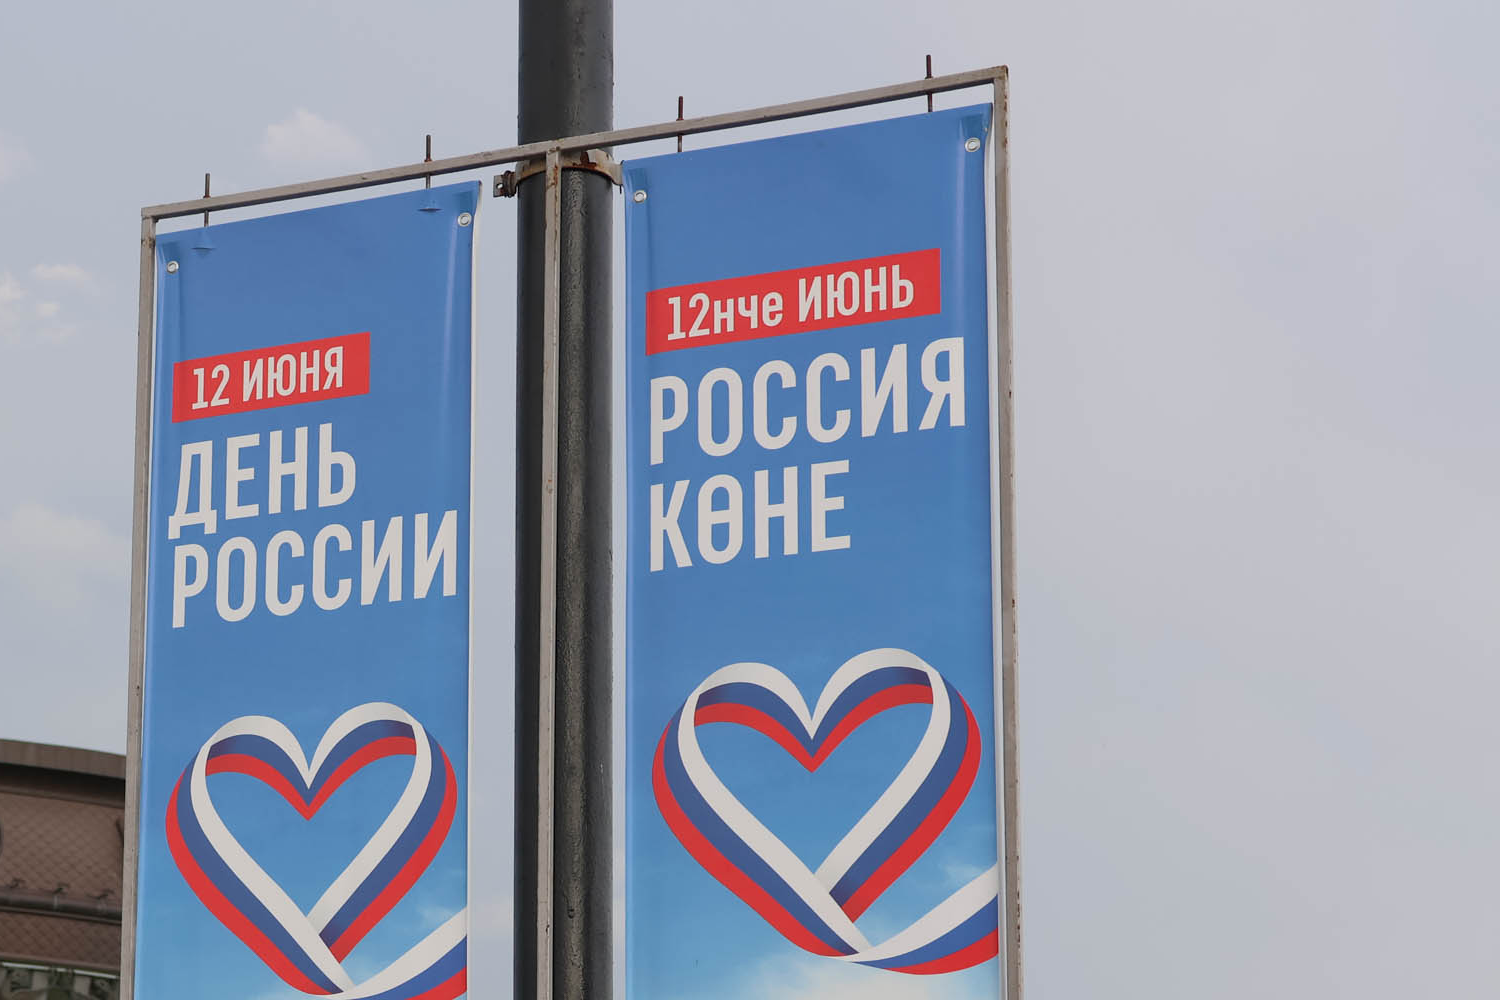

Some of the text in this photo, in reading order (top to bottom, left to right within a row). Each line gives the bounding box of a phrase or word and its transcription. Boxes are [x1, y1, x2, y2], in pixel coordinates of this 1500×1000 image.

[667, 264, 914, 341] 12нче ИЮНЬ
[191, 345, 344, 410] 12 ИЮНЯ
[650, 336, 966, 466] РОССИЯ
[167, 422, 356, 540] ДЕНЬ
[650, 459, 851, 573] КӨНЕ
[172, 509, 458, 629] РОССИИ
